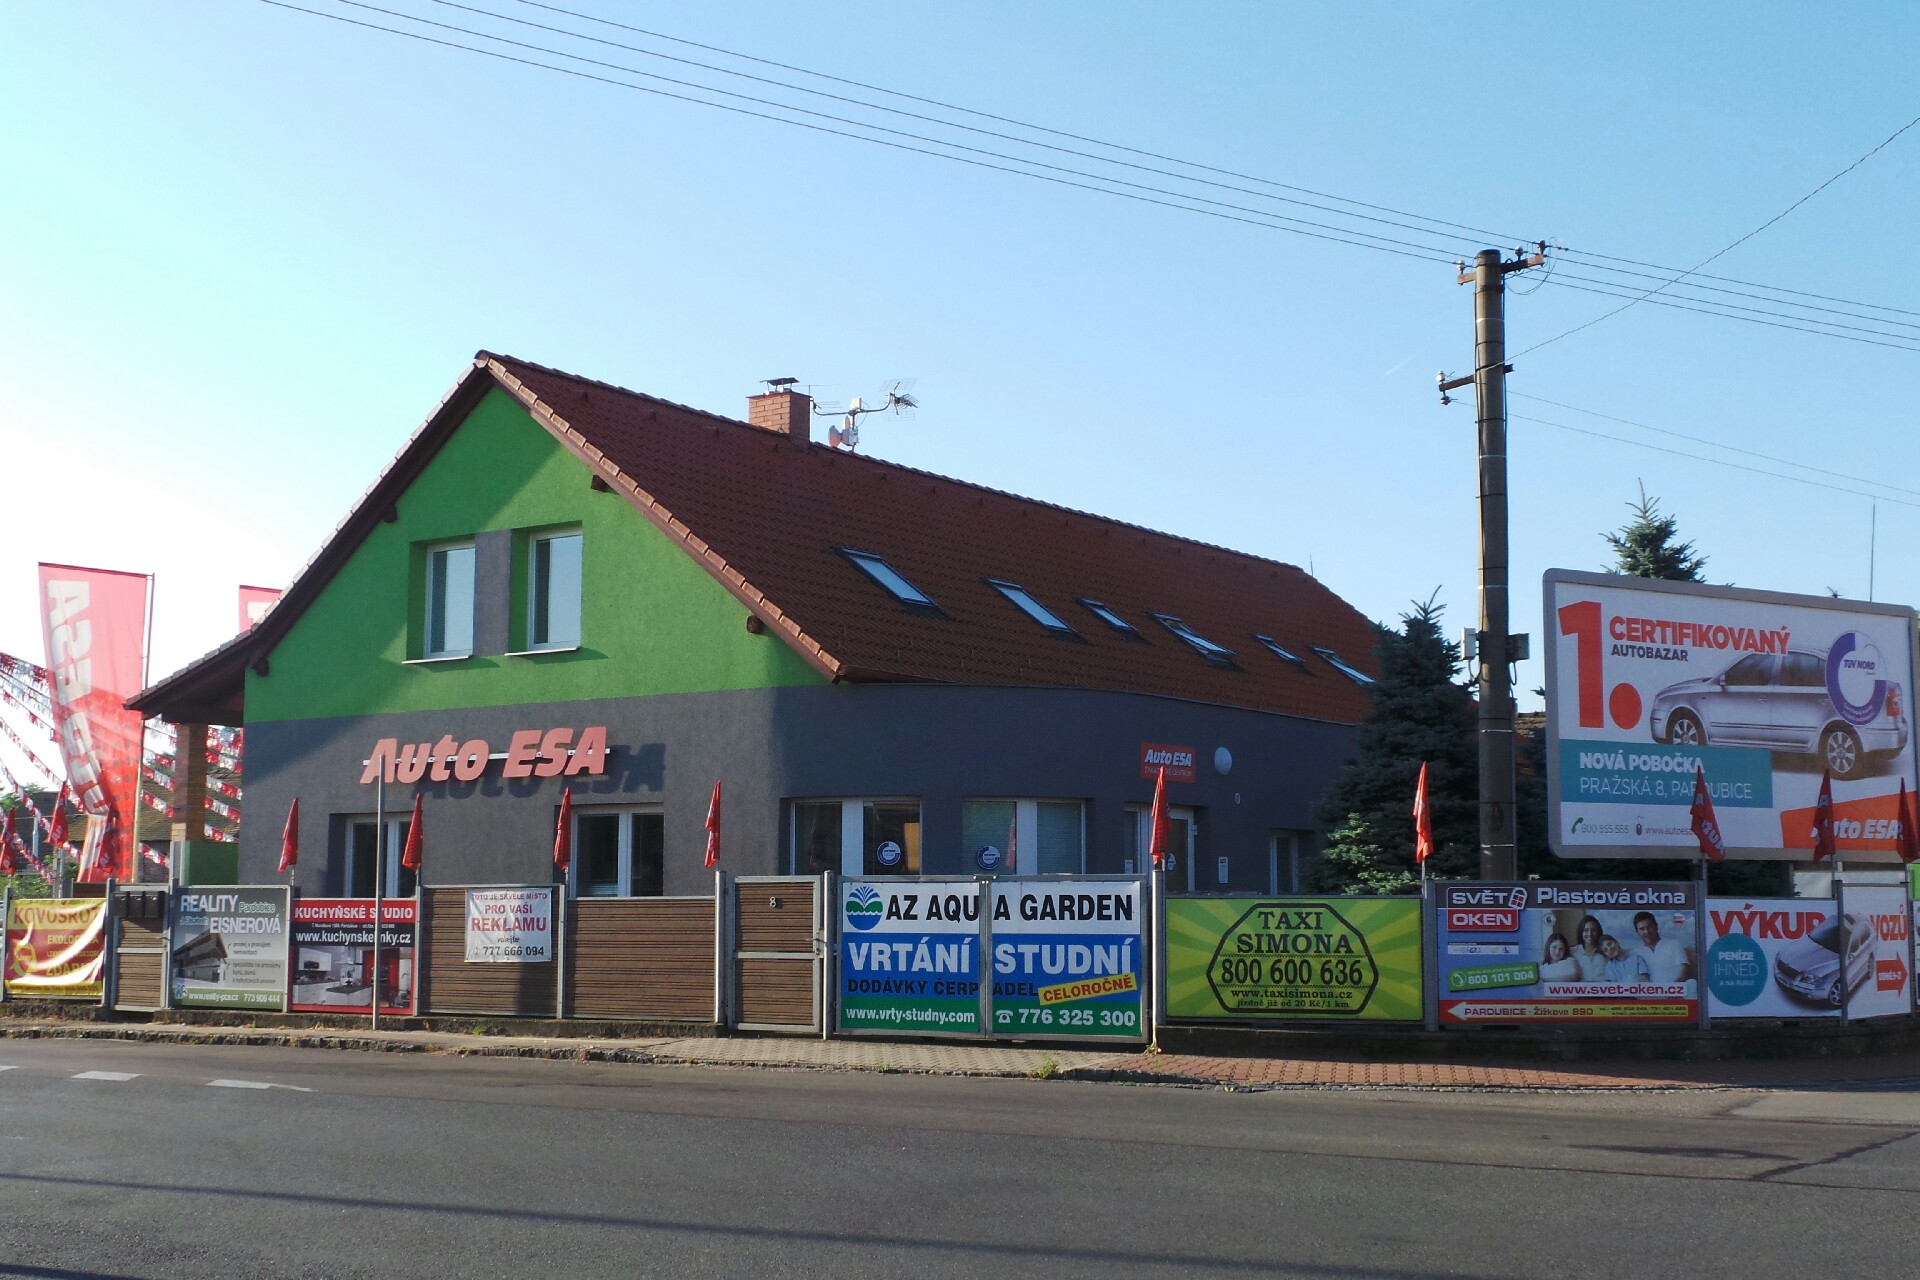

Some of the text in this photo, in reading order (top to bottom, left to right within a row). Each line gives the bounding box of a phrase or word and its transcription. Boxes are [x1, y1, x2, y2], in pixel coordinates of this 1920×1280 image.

[1609, 615, 1790, 655] CERTIFIKOVANÝ
[1611, 644, 1689, 662] AUTOBAZAR
[360, 726, 607, 784] Auto ESA
[1145, 749, 1192, 767] Auto ESA
[1579, 749, 1705, 774] NOVÁ POBOČKA
[1580, 775, 1651, 796] PRAŽSKÁ
[1810, 818, 1899, 839] uto ESA
[181, 894, 239, 913] REALITY
[472, 893, 488, 901] TOTO
[1452, 889, 1508, 905] SVĚT
[1536, 887, 1686, 905] Plastová okna
[294, 904, 366, 919] KUCHYŇSKÉ
[484, 902, 533, 914] PRO VAŠI
[886, 894, 919, 921] AZ
[1020, 894, 1133, 921] GARDEN
[209, 913, 282, 934] EISNEROVÁ
[471, 916, 547, 932] REKLAMU
[1257, 911, 1324, 931] TAXI
[1452, 912, 1513, 927] OKEN
[295, 930, 411, 946] www.kuchynskelnky.cz
[497, 935, 520, 944] volejte
[1236, 933, 1355, 955] SIMONA
[483, 946, 545, 956] 777 666 094
[848, 936, 1134, 976] VRTÁNÍ STUDNÍ
[1718, 949, 1754, 961] PENÍZE
[1221, 957, 1363, 985] 800 600 636
[1714, 963, 1760, 977] IHNED
[847, 976, 927, 995] DODÁVKY
[1042, 974, 1134, 1003] CELOROČNĚ
[1230, 987, 1353, 1000] www.taxisimona.cz
[1548, 984, 1685, 996] www.svet-oken.cz
[1281, 999, 1292, 1007] od
[1335, 1000, 1349, 1008] km
[1464, 1007, 1527, 1016] PARDUBICE
[1533, 1005, 1569, 1016] Žižkova
[846, 1007, 1136, 1026] www.vrty-studny.com 776 325 300
